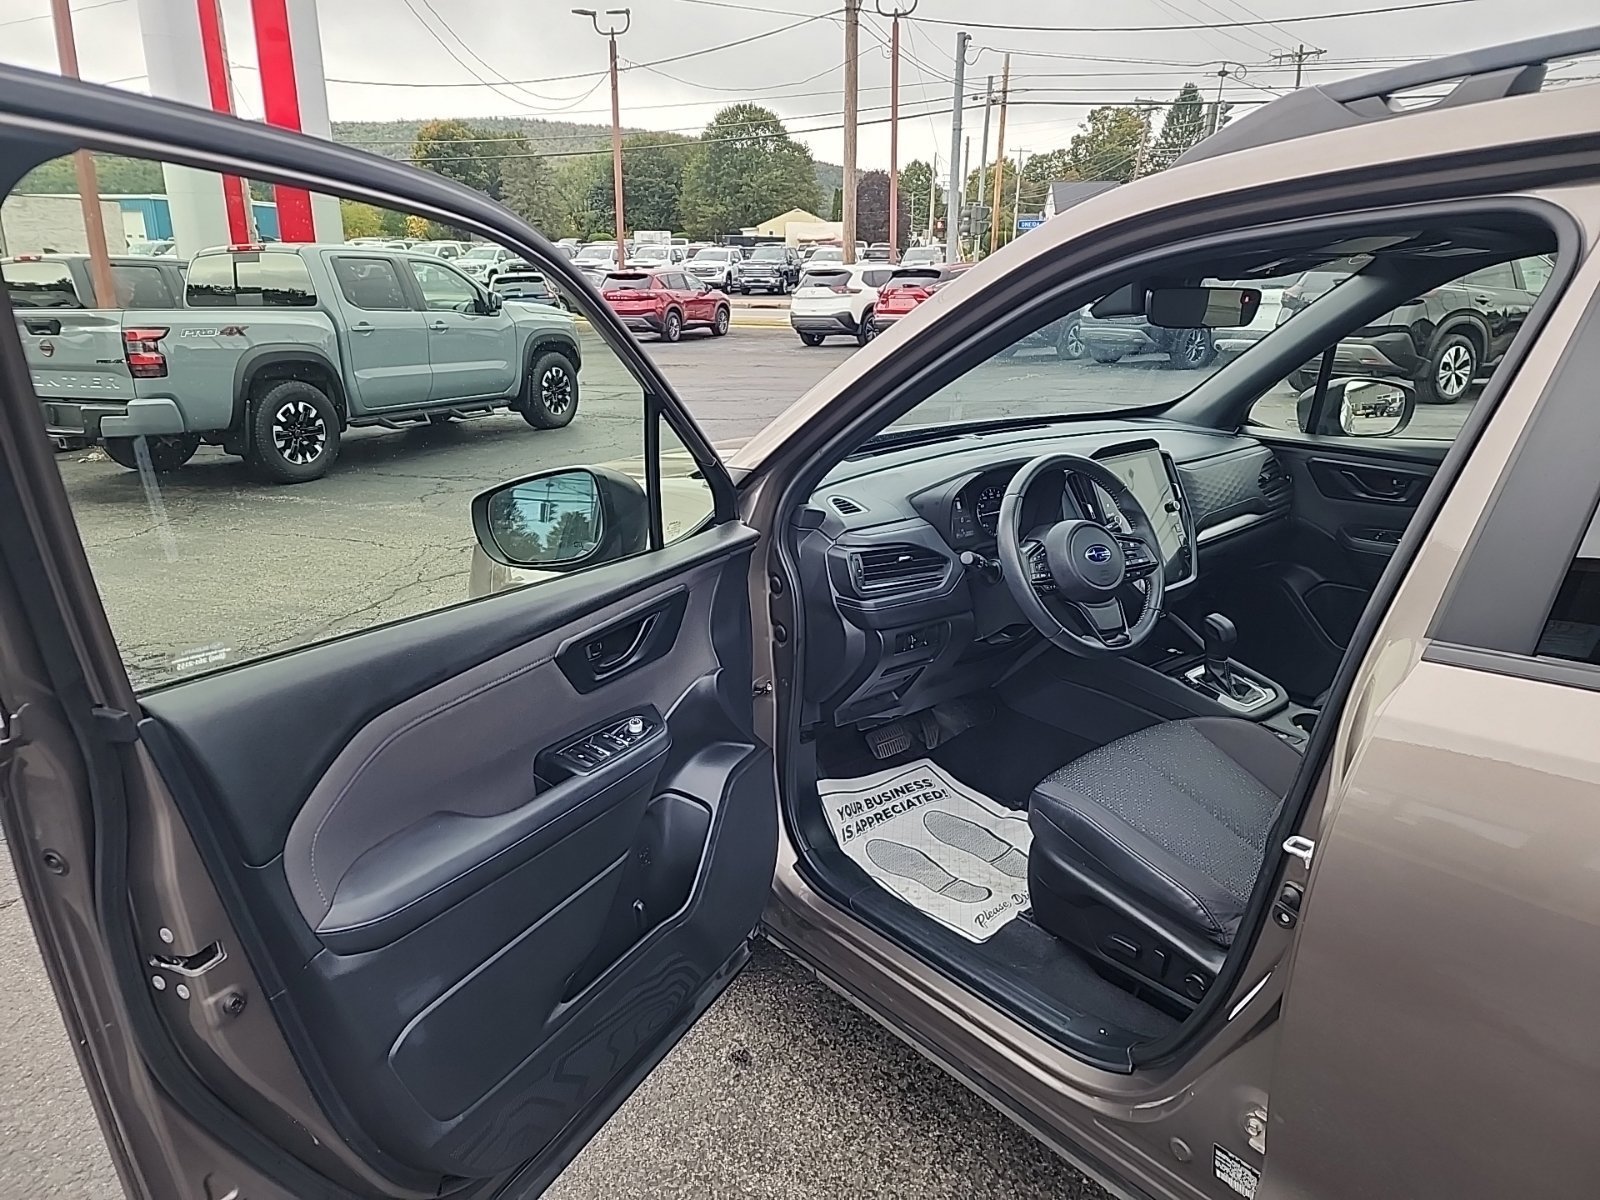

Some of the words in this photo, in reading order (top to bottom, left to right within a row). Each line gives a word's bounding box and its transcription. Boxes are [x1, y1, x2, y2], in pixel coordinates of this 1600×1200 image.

[836, 801, 865, 822] YOUR
[863, 779, 935, 811] BUSINESS
[841, 825, 854, 842] IS
[854, 788, 950, 835] APPRECIATED!
[1011, 890, 1030, 906] Dri
